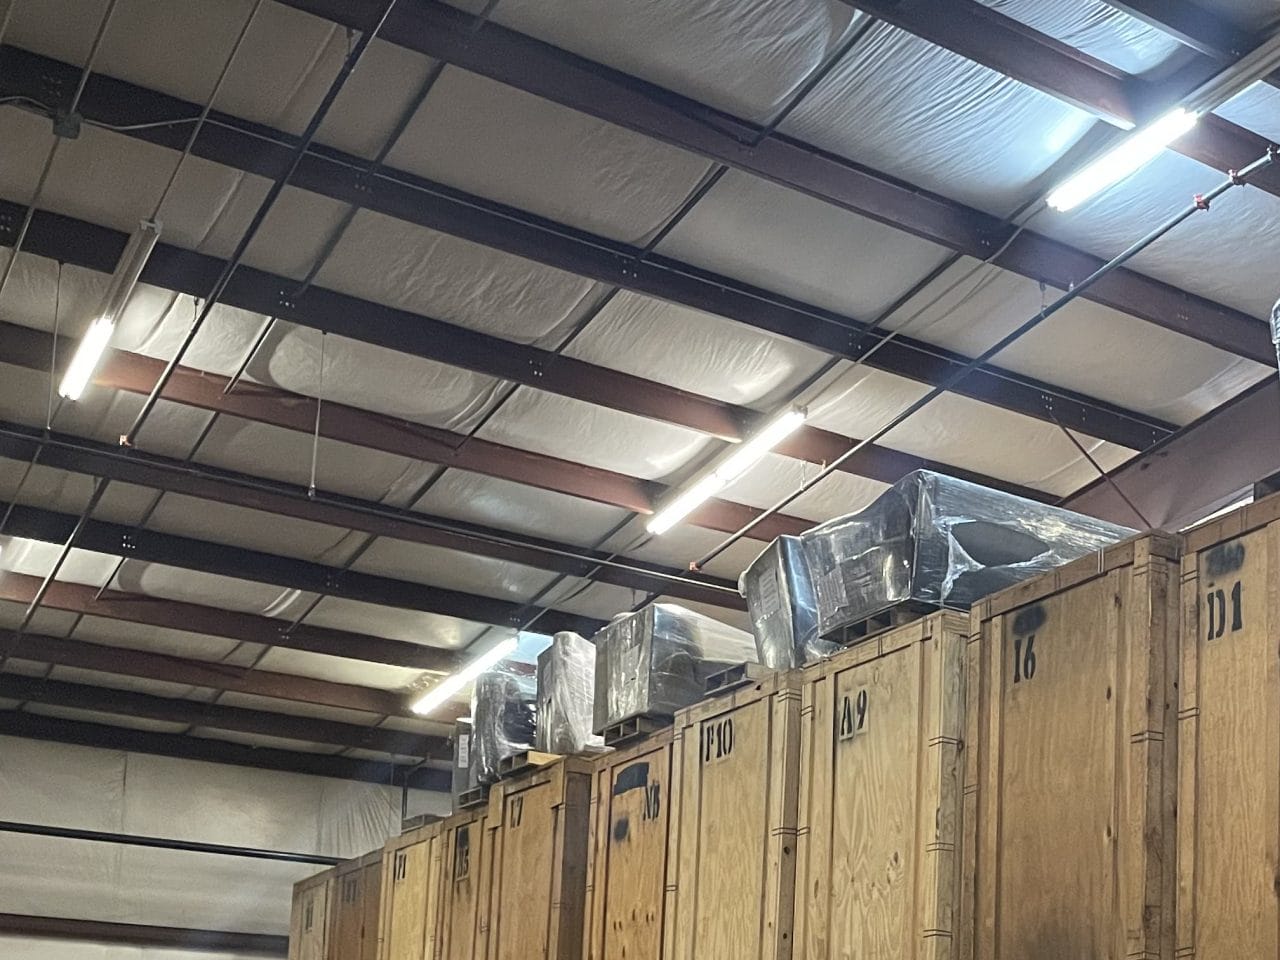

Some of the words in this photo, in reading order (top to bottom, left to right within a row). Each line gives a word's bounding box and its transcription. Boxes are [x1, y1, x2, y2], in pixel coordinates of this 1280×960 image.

[1207, 581, 1243, 641] D1
[841, 689, 867, 736] A9
[706, 718, 733, 761] F10
